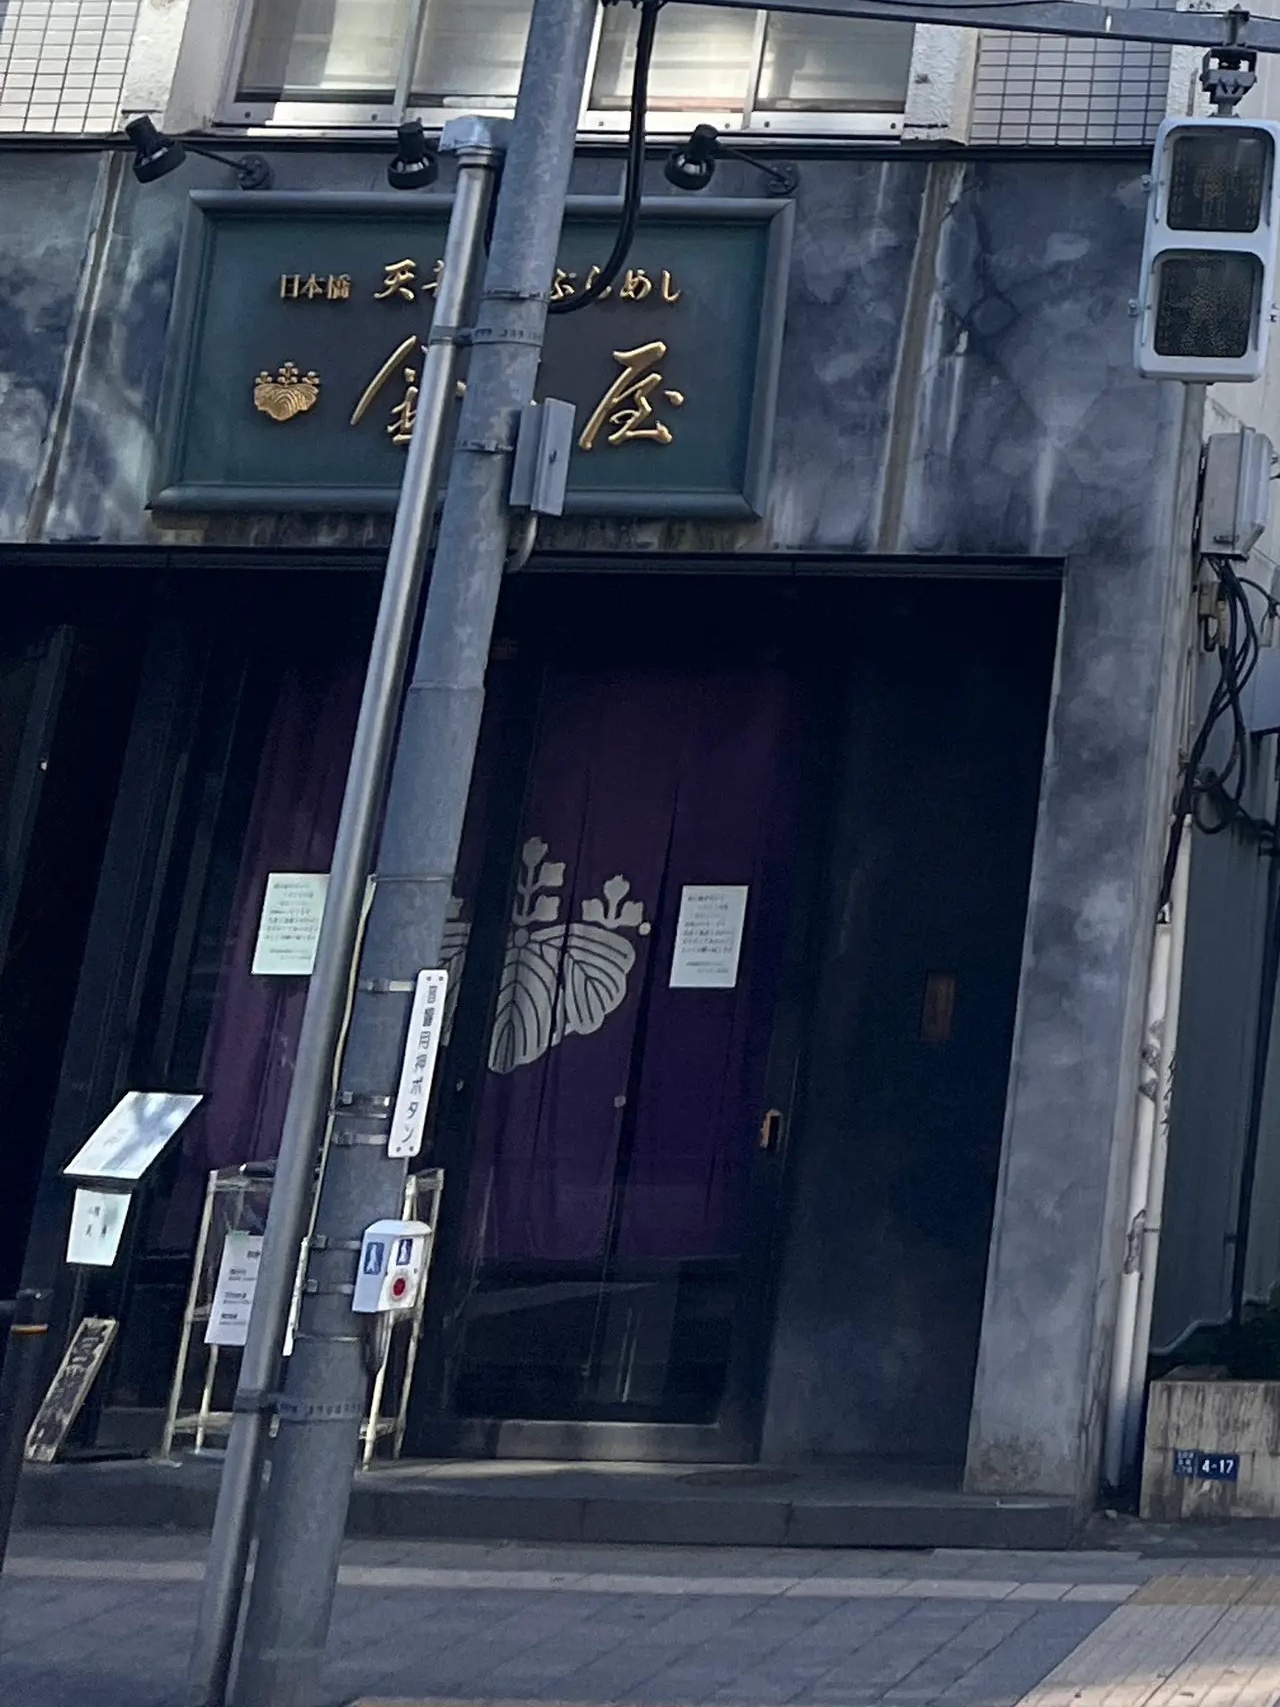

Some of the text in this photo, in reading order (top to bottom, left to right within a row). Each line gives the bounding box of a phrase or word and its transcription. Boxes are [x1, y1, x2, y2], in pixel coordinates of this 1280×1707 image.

[280, 273, 352, 300] 日本橋
[1201, 1458, 1235, 1475] 4-17
